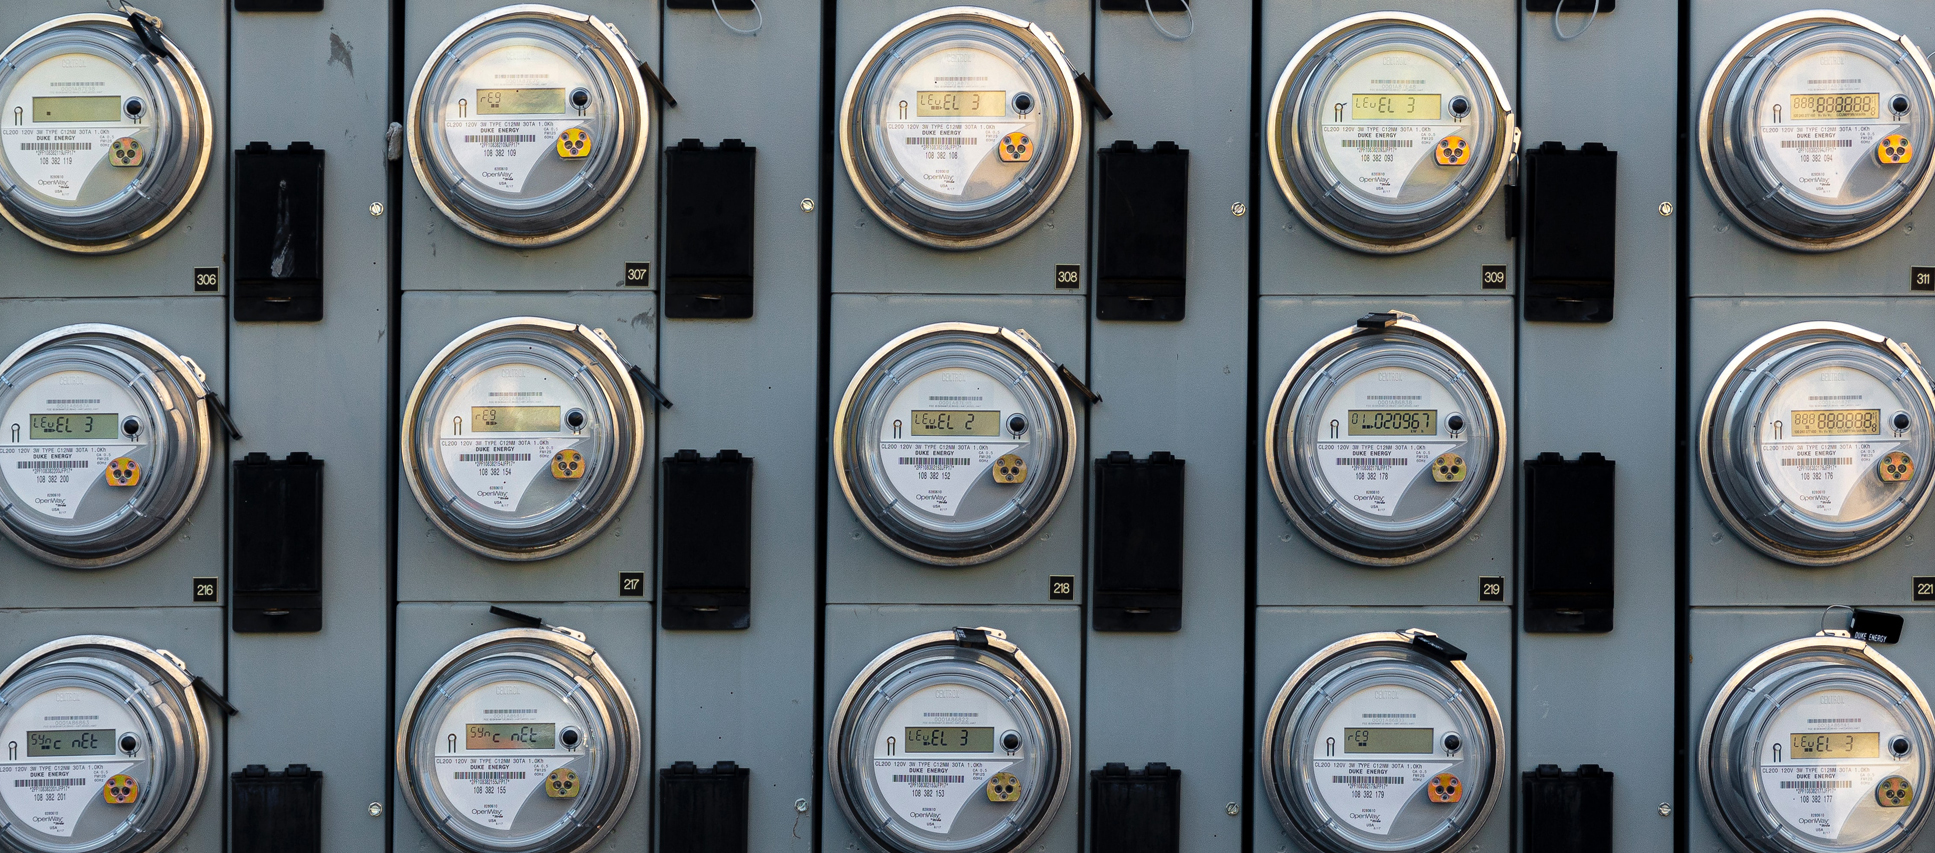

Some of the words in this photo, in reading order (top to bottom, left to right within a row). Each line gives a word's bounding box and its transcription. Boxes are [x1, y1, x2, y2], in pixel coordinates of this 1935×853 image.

[972, 94, 980, 110] 3
[1407, 97, 1415, 113] 3
[484, 149, 493, 157] 108
[495, 149, 504, 157] 382
[507, 149, 516, 157] 109
[197, 274, 216, 285] 306
[628, 269, 646, 280] 307
[1058, 271, 1077, 282] 308
[1484, 272, 1504, 283] 309
[1917, 273, 1930, 284] 311
[85, 417, 93, 433] 3
[965, 414, 975, 430] 2
[1375, 413, 1429, 429] 020967
[1801, 472, 1810, 480] 108
[1812, 472, 1822, 480] 382
[1824, 472, 1833, 480] 176
[197, 584, 213, 595] 216
[624, 579, 639, 589] 217
[1054, 583, 1070, 594] 218
[1483, 583, 1500, 595] 219
[1918, 583, 1934, 594] 221
[1854, 631, 1867, 640] DUKE
[1868, 634, 1887, 643] ENERGY
[960, 730, 969, 746] 3
[1845, 735, 1853, 752] 3
[34, 793, 43, 801] 108
[46, 793, 55, 801] 382
[57, 793, 66, 801] 201
